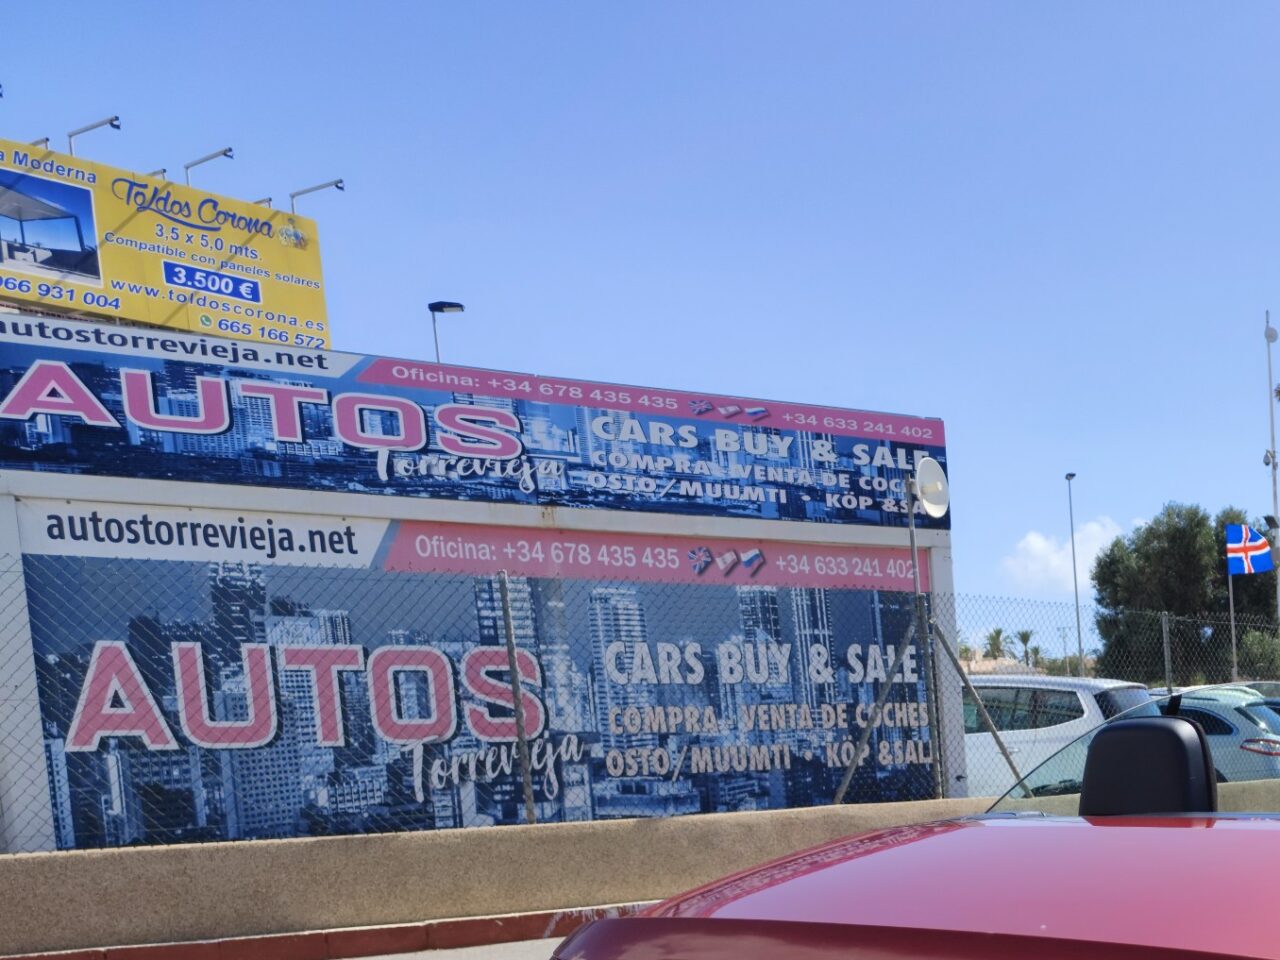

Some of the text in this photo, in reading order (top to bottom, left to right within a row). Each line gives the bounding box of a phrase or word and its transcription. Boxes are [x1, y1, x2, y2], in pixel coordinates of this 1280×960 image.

[13, 151, 97, 183] Moderna
[112, 178, 274, 238] Toldos Corona
[105, 232, 320, 290] Compatible con paneles solares
[155, 223, 262, 261] 3,5 x 5,0 mts.
[0, 277, 120, 310] 66 931 004
[173, 266, 254, 299] 3.500 €
[111, 280, 324, 331] www.toldoscorona.es
[218, 319, 325, 349] 665 166 572
[392, 366, 678, 410] Oficina: +34 678 435 435
[0, 359, 523, 460] AUTOS
[783, 412, 933, 439] +34 633 241 402
[592, 416, 699, 449] CARS
[714, 428, 793, 458] BUY
[812, 440, 838, 463] &
[370, 446, 564, 494] Torrevieja
[592, 451, 712, 476] COMPRA
[733, 464, 813, 487] VENTA
[823, 473, 850, 488] DE
[826, 491, 873, 511] KÖP
[46, 512, 358, 558] autostorrevieja.net
[415, 535, 679, 569] Oficina: +34 678 435 435
[776, 554, 915, 579] +34 633 241 402
[605, 642, 918, 685] CARS BUY & SALE
[65, 640, 546, 751] AUTOS
[608, 704, 719, 735] COMPRA
[741, 703, 814, 731] VENTA
[821, 703, 848, 728] DE
